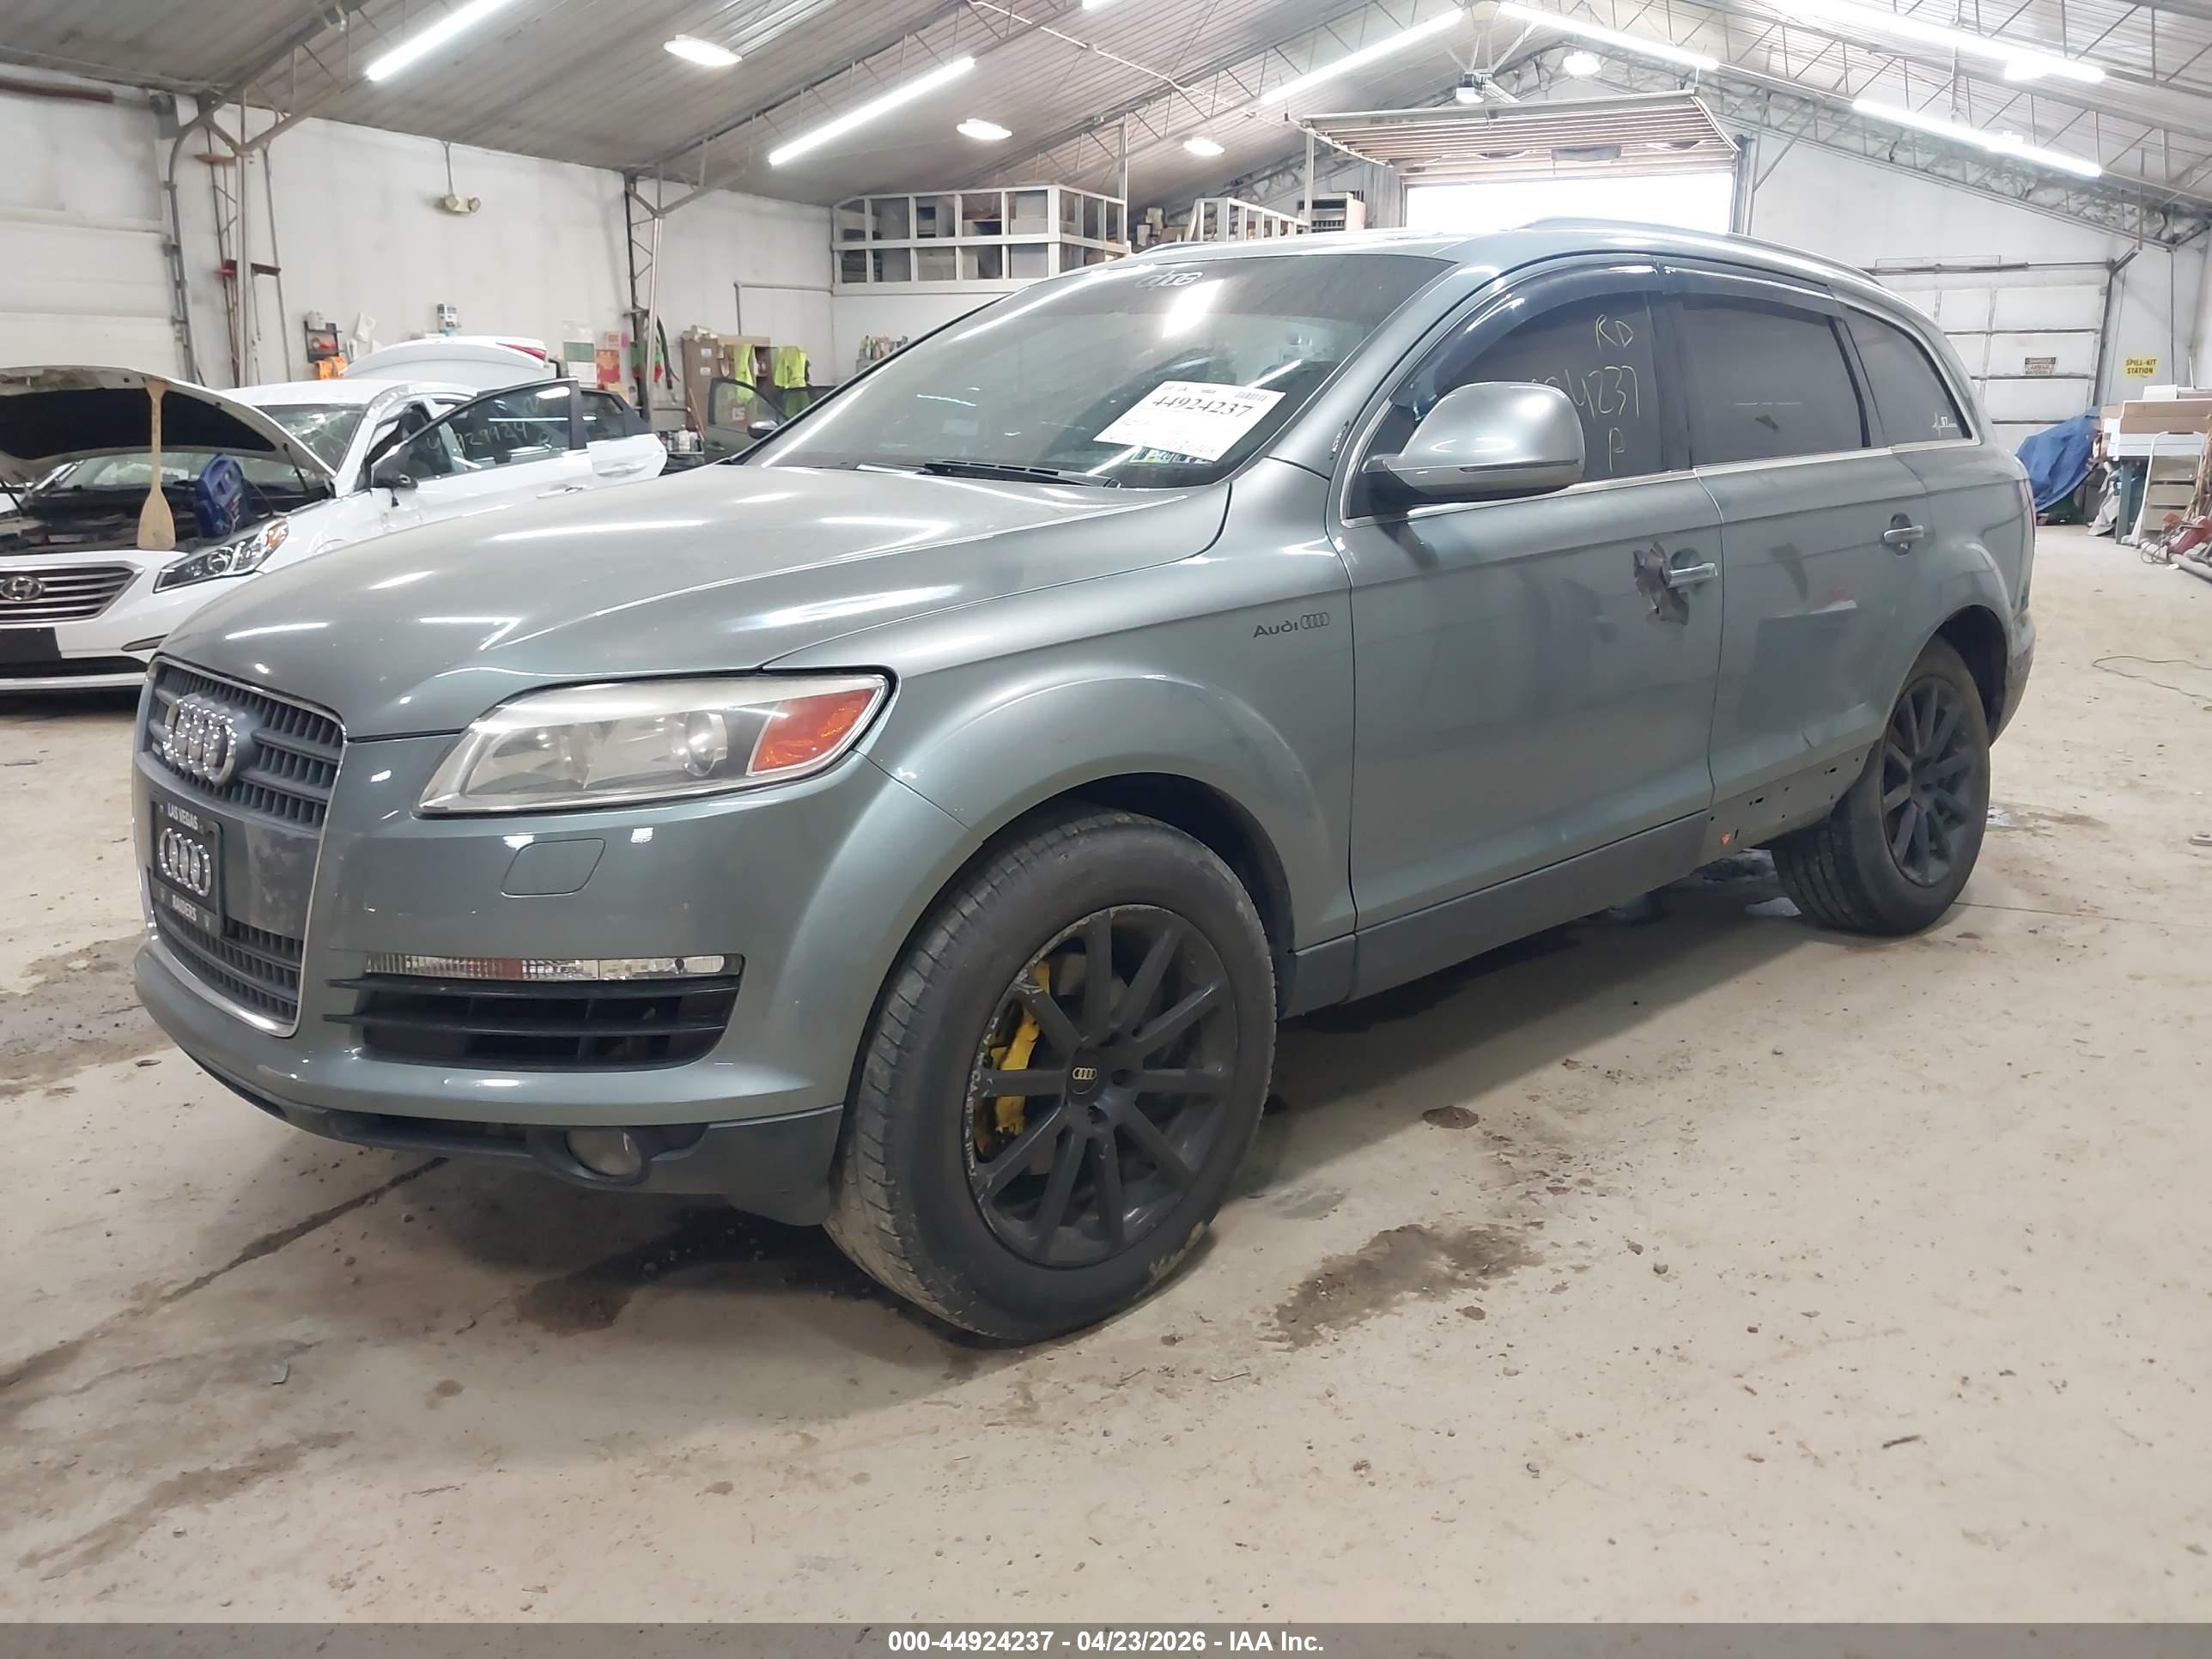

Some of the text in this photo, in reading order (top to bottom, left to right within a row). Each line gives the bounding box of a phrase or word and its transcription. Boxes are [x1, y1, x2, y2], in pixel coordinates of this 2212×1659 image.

[1595, 313, 1635, 350] RD
[2125, 358, 2158, 367] SPILL-KIT
[2126, 367, 2154, 375] STATION
[1152, 395, 1255, 418] 44924237
[1607, 427, 1626, 473] P
[1253, 620, 1299, 638] Audi
[167, 802, 199, 831] LAS VEGAS
